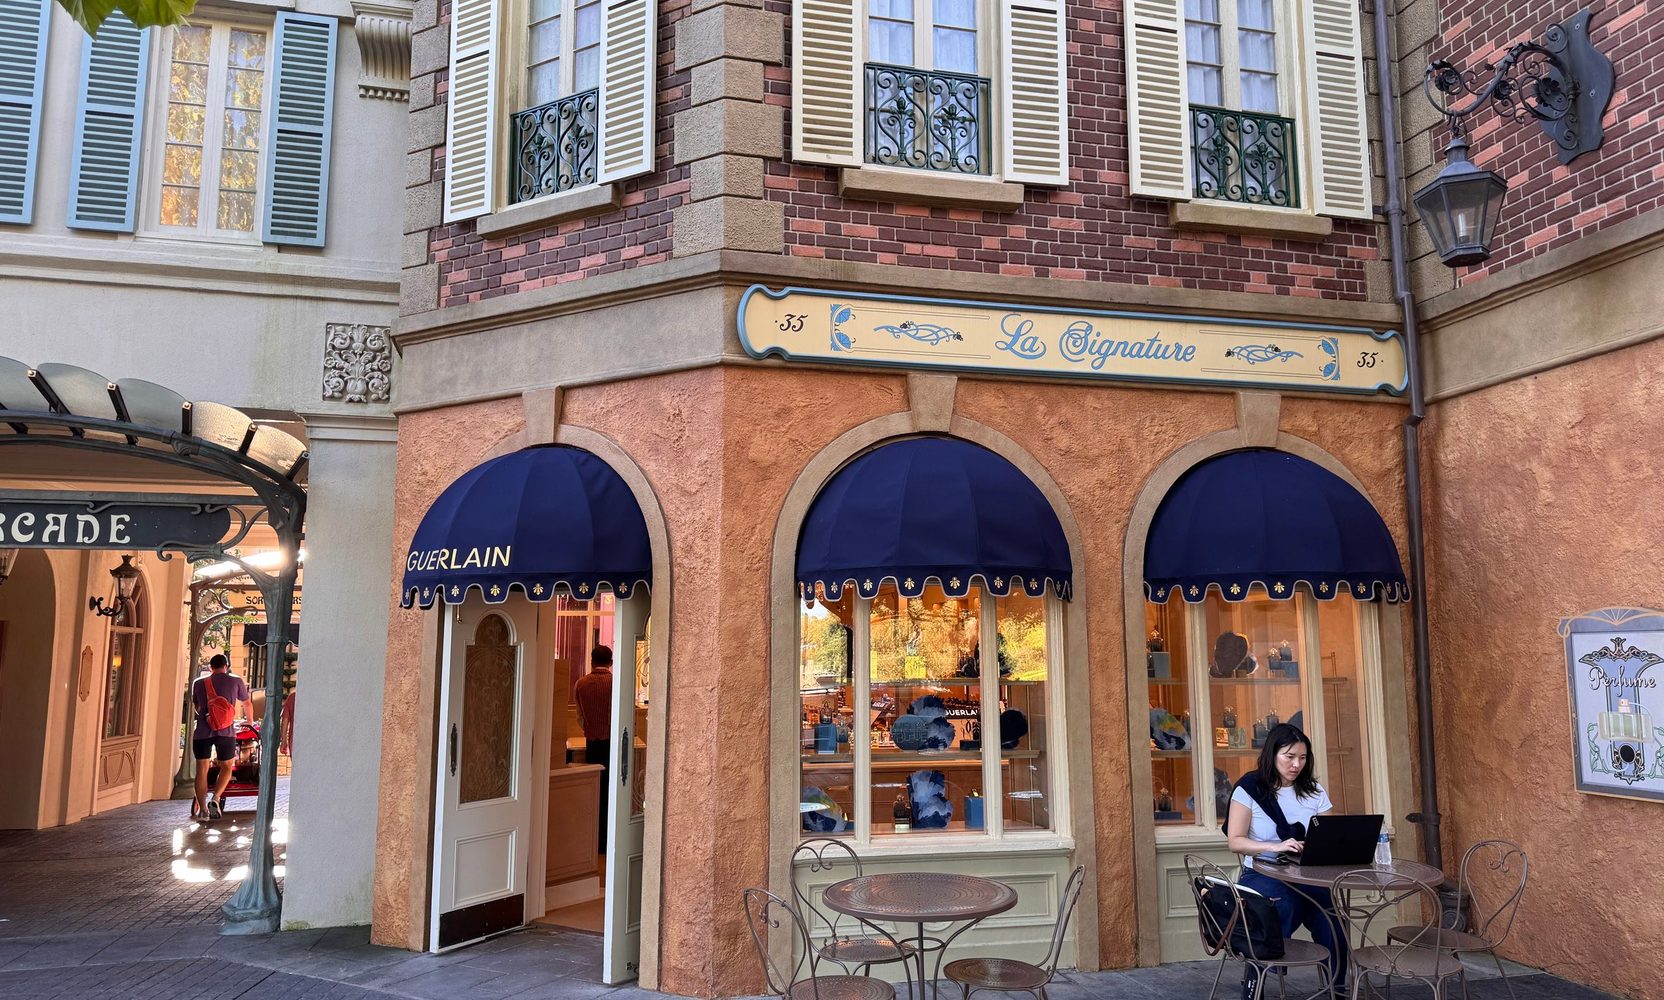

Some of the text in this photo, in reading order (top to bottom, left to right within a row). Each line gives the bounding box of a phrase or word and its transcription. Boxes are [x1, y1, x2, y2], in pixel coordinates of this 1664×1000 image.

[779, 313, 808, 332] 35
[994, 313, 1197, 370] La Signature
[1356, 351, 1379, 368] 35
[0, 512, 131, 544] CADE
[406, 545, 511, 572] GUERLAIN
[1588, 664, 1657, 698] Perfume
